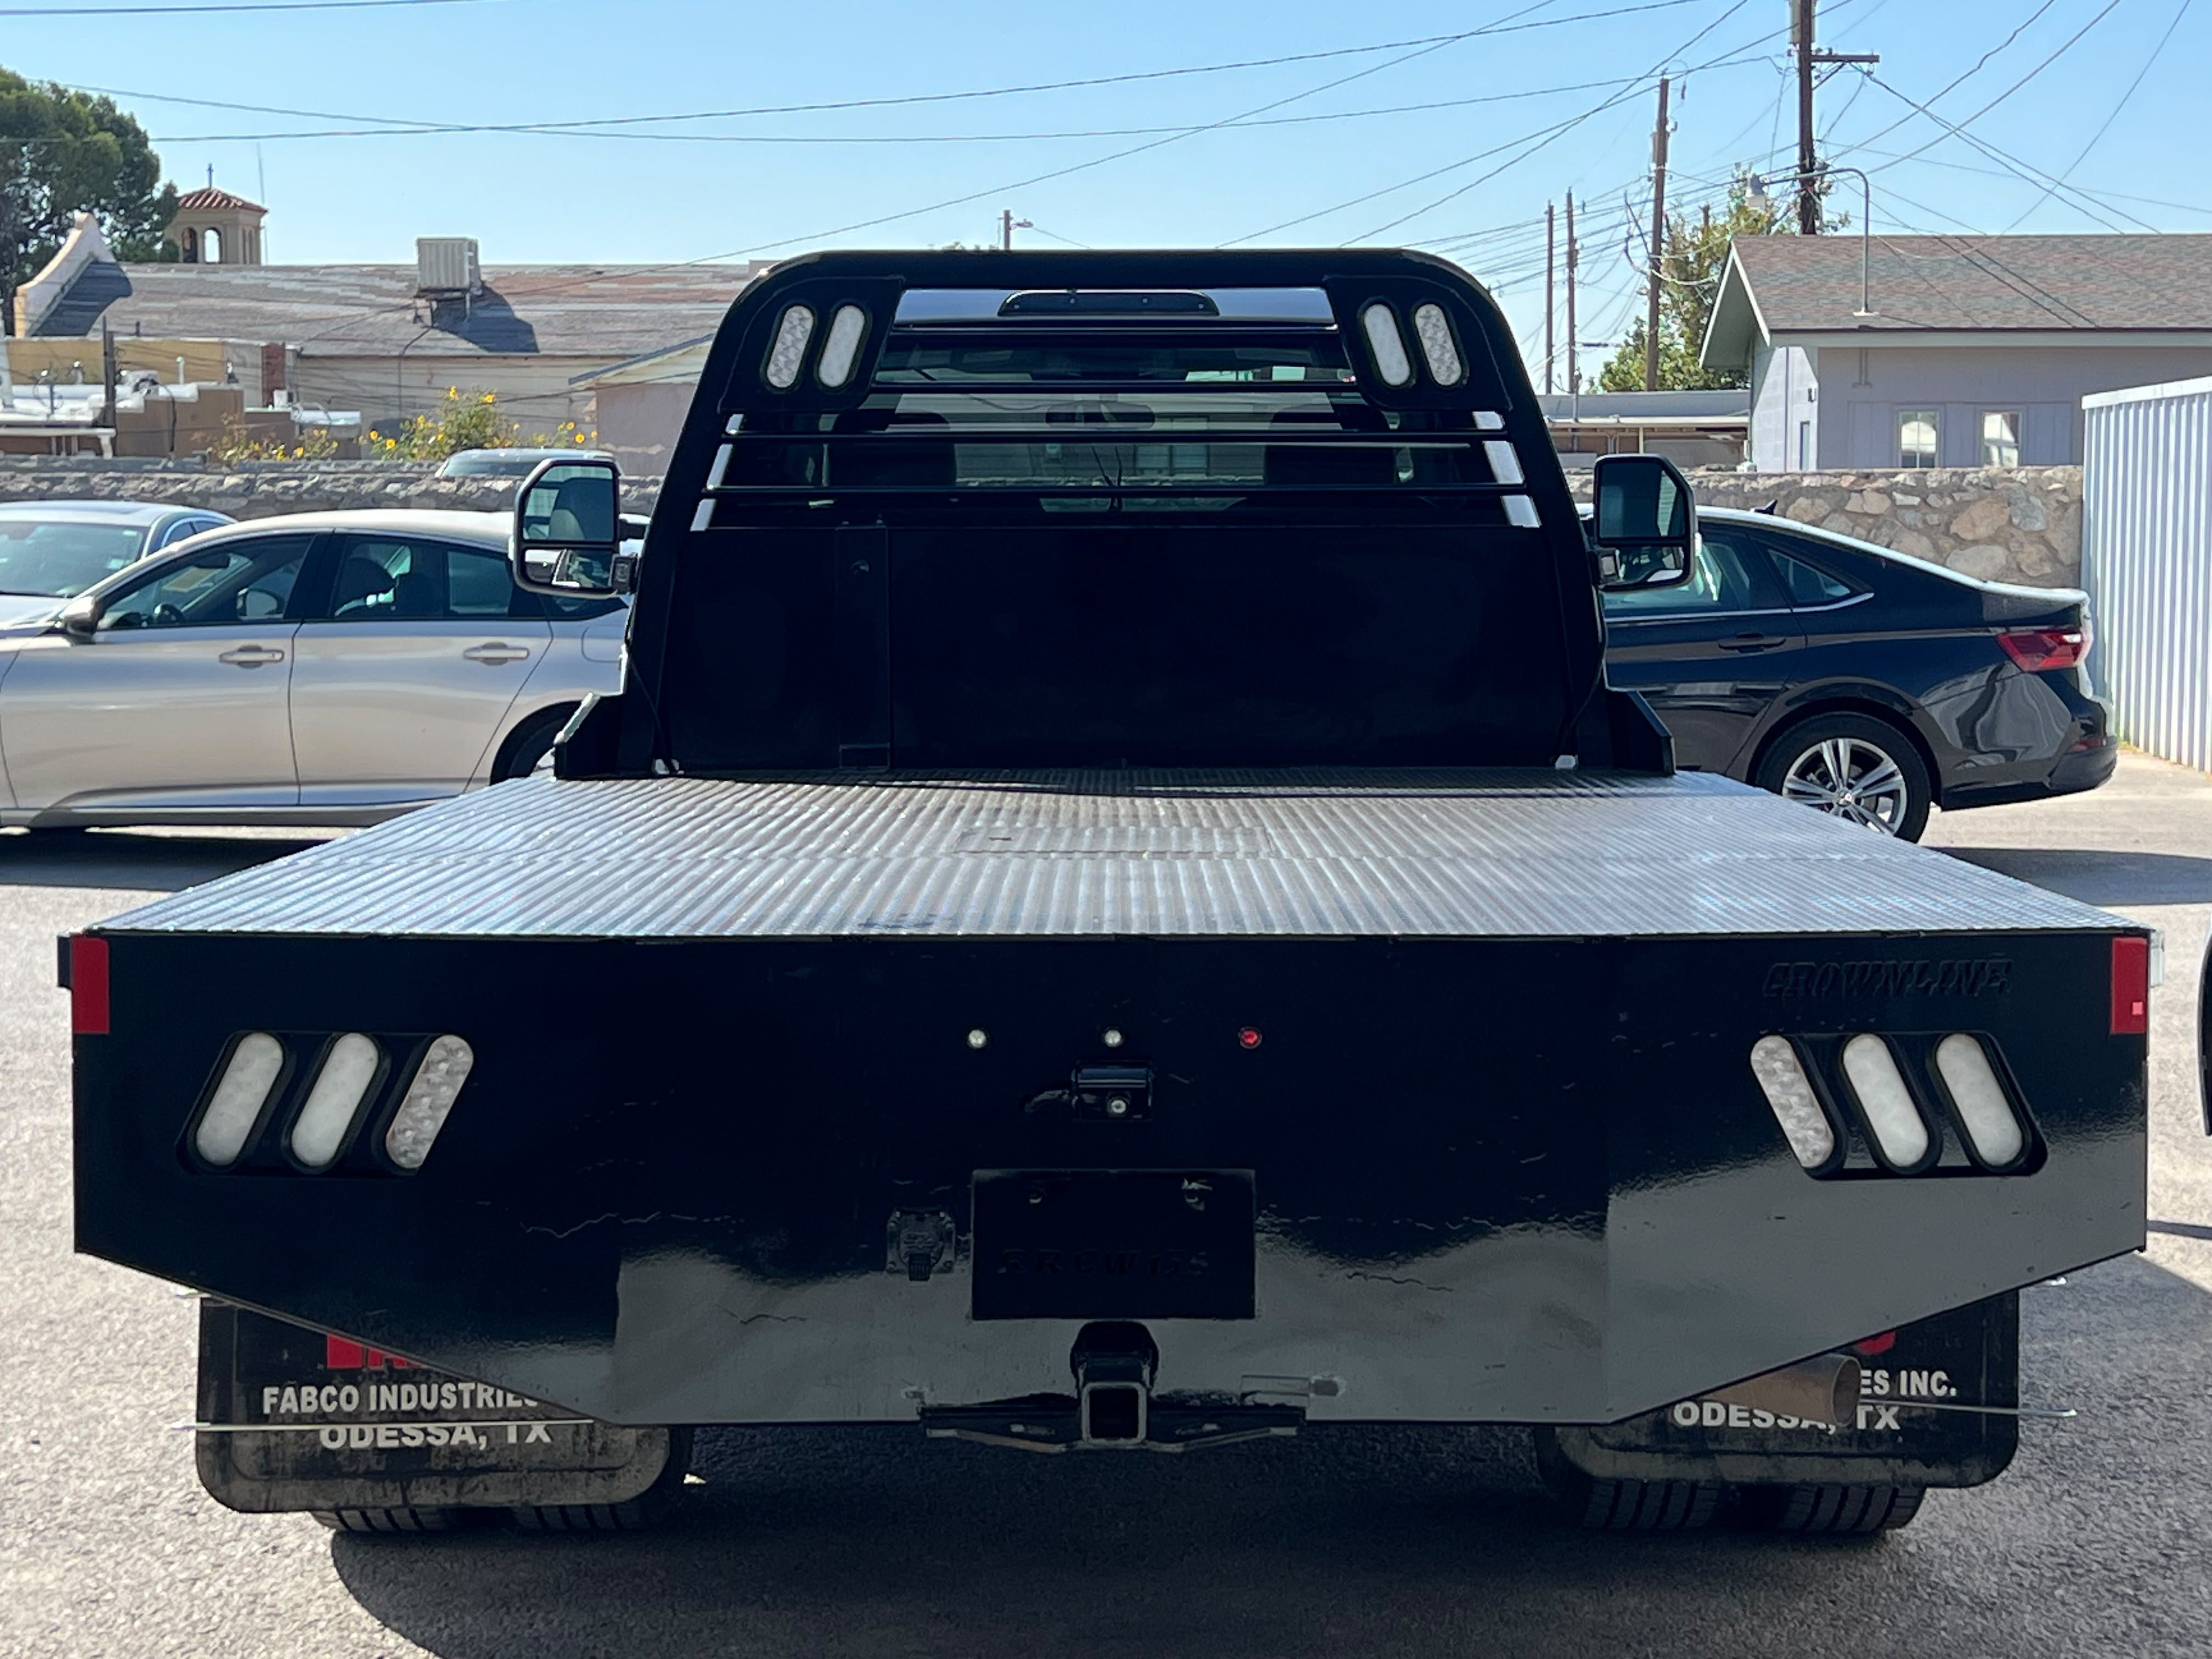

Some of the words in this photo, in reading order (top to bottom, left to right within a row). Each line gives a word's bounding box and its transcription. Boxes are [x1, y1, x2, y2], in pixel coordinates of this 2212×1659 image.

[1899, 1369, 1957, 1397] INC.
[262, 1385, 360, 1414] FABCO
[319, 1425, 488, 1451] ODESSA,
